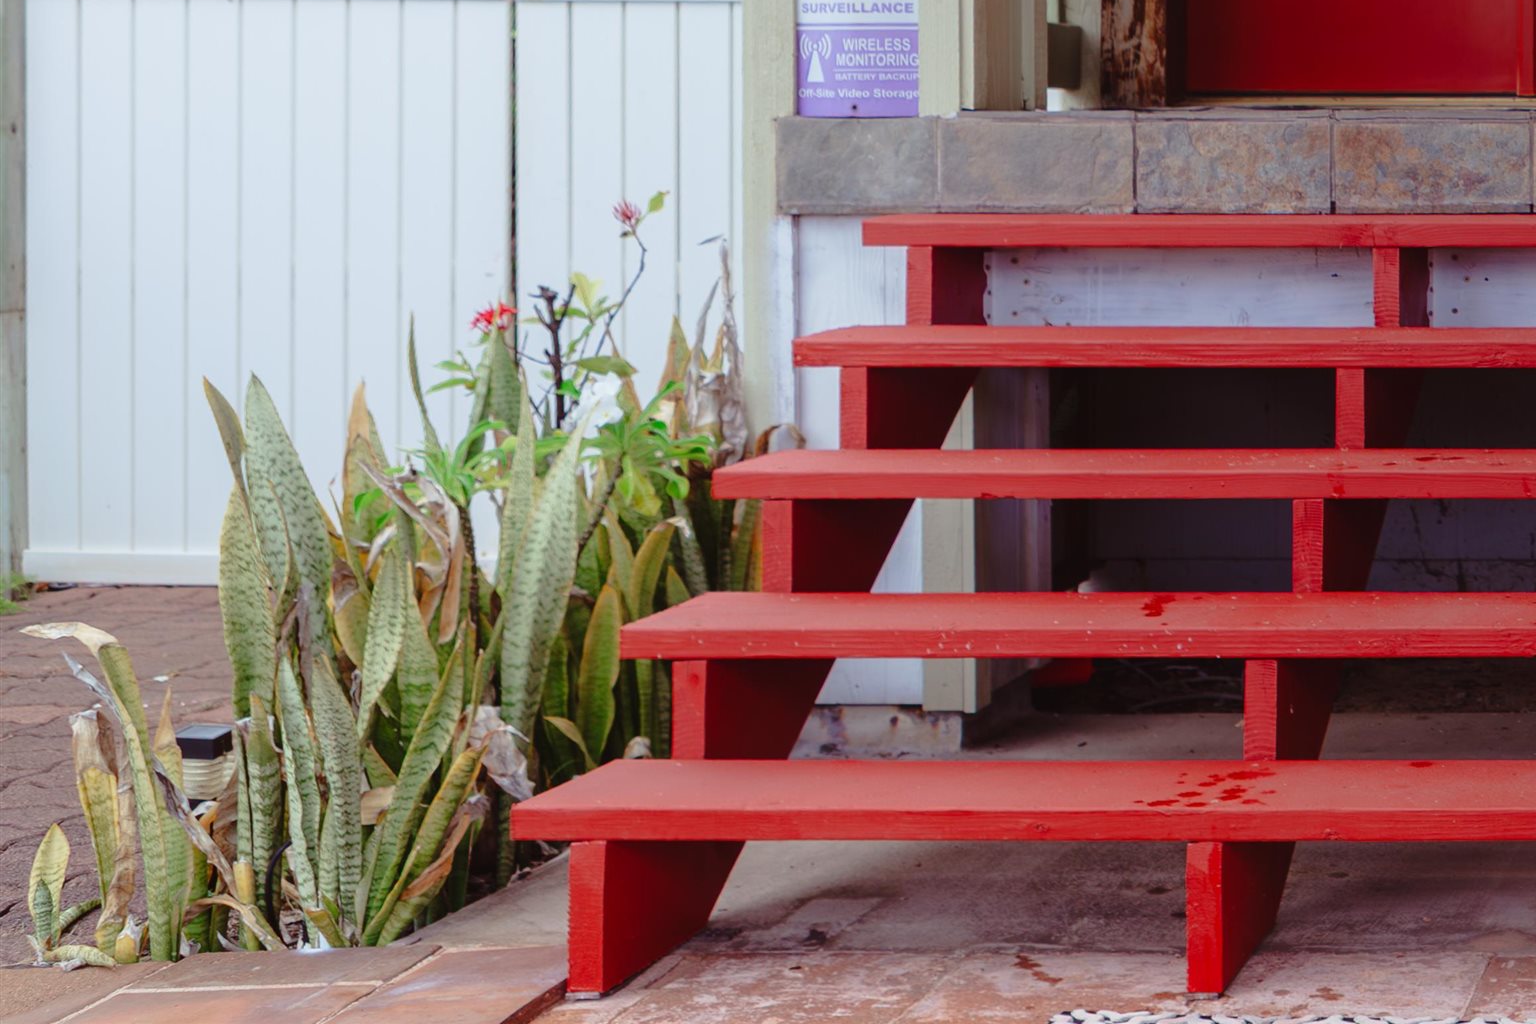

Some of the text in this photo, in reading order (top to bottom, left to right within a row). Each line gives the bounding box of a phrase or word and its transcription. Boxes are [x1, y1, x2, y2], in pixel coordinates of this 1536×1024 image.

[801, 2, 914, 14] SURVEILLANCE
[842, 37, 911, 52] WIRELESS
[835, 53, 919, 67] MONITORING
[834, 72, 876, 81] BATTERY
[837, 88, 870, 99] Video
